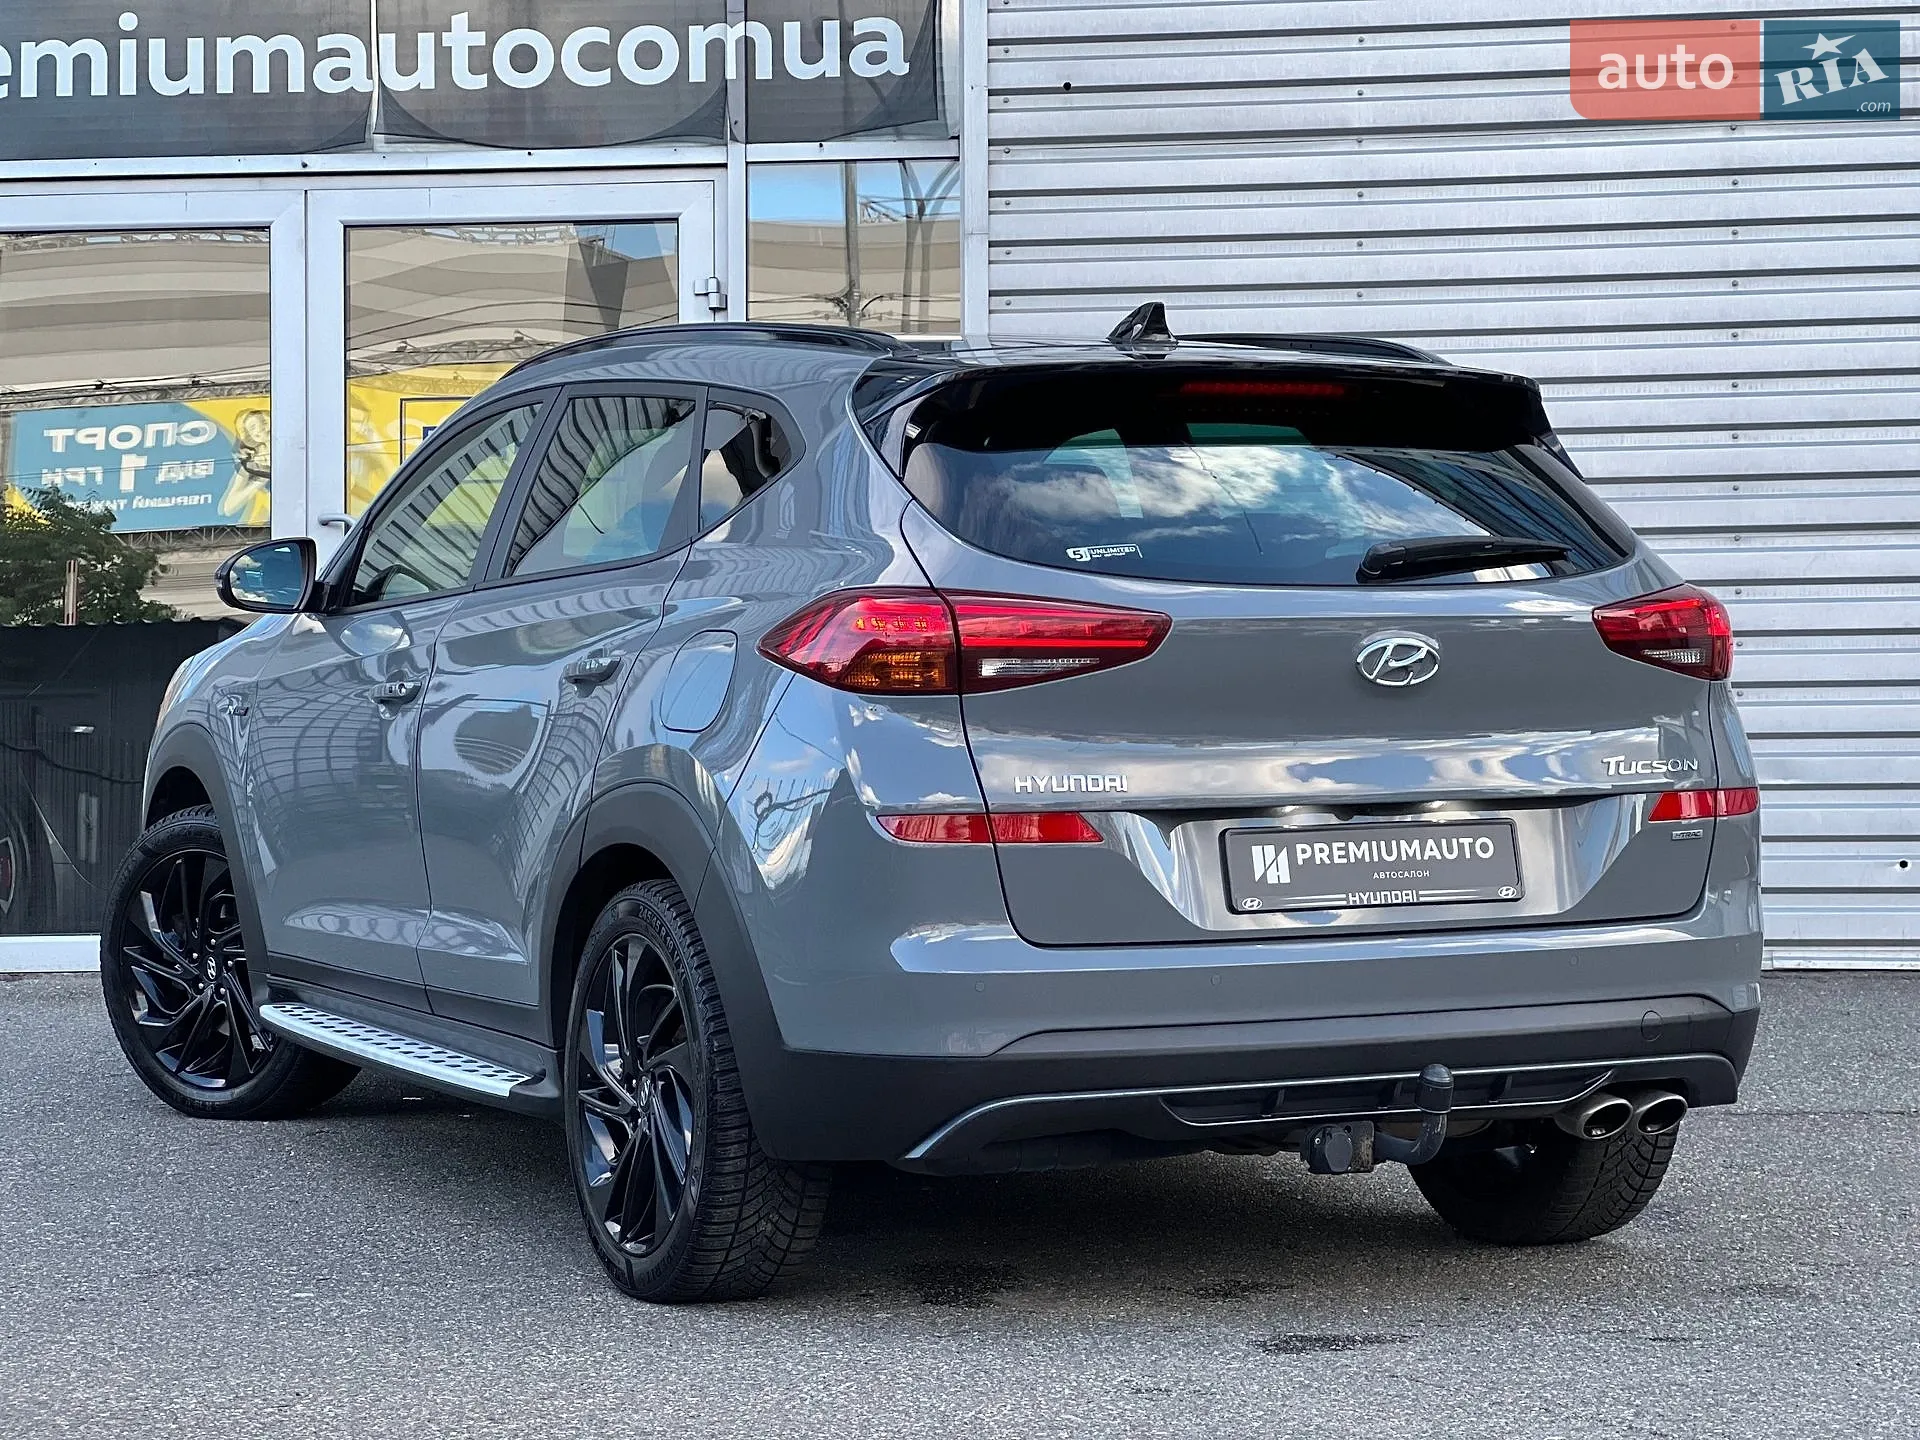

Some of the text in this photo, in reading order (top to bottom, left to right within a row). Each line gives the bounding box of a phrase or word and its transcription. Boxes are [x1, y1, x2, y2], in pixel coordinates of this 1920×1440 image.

[0, 11, 909, 98] miumautocomua
[1090, 546, 1136, 555] UNLIMITED
[1014, 774, 1128, 793] HYUNDAI
[1295, 836, 1495, 865] PREMIUMAUTO
[1372, 869, 1430, 880] АВТОСАЛОН
[1348, 889, 1418, 904] HYUNDAI
